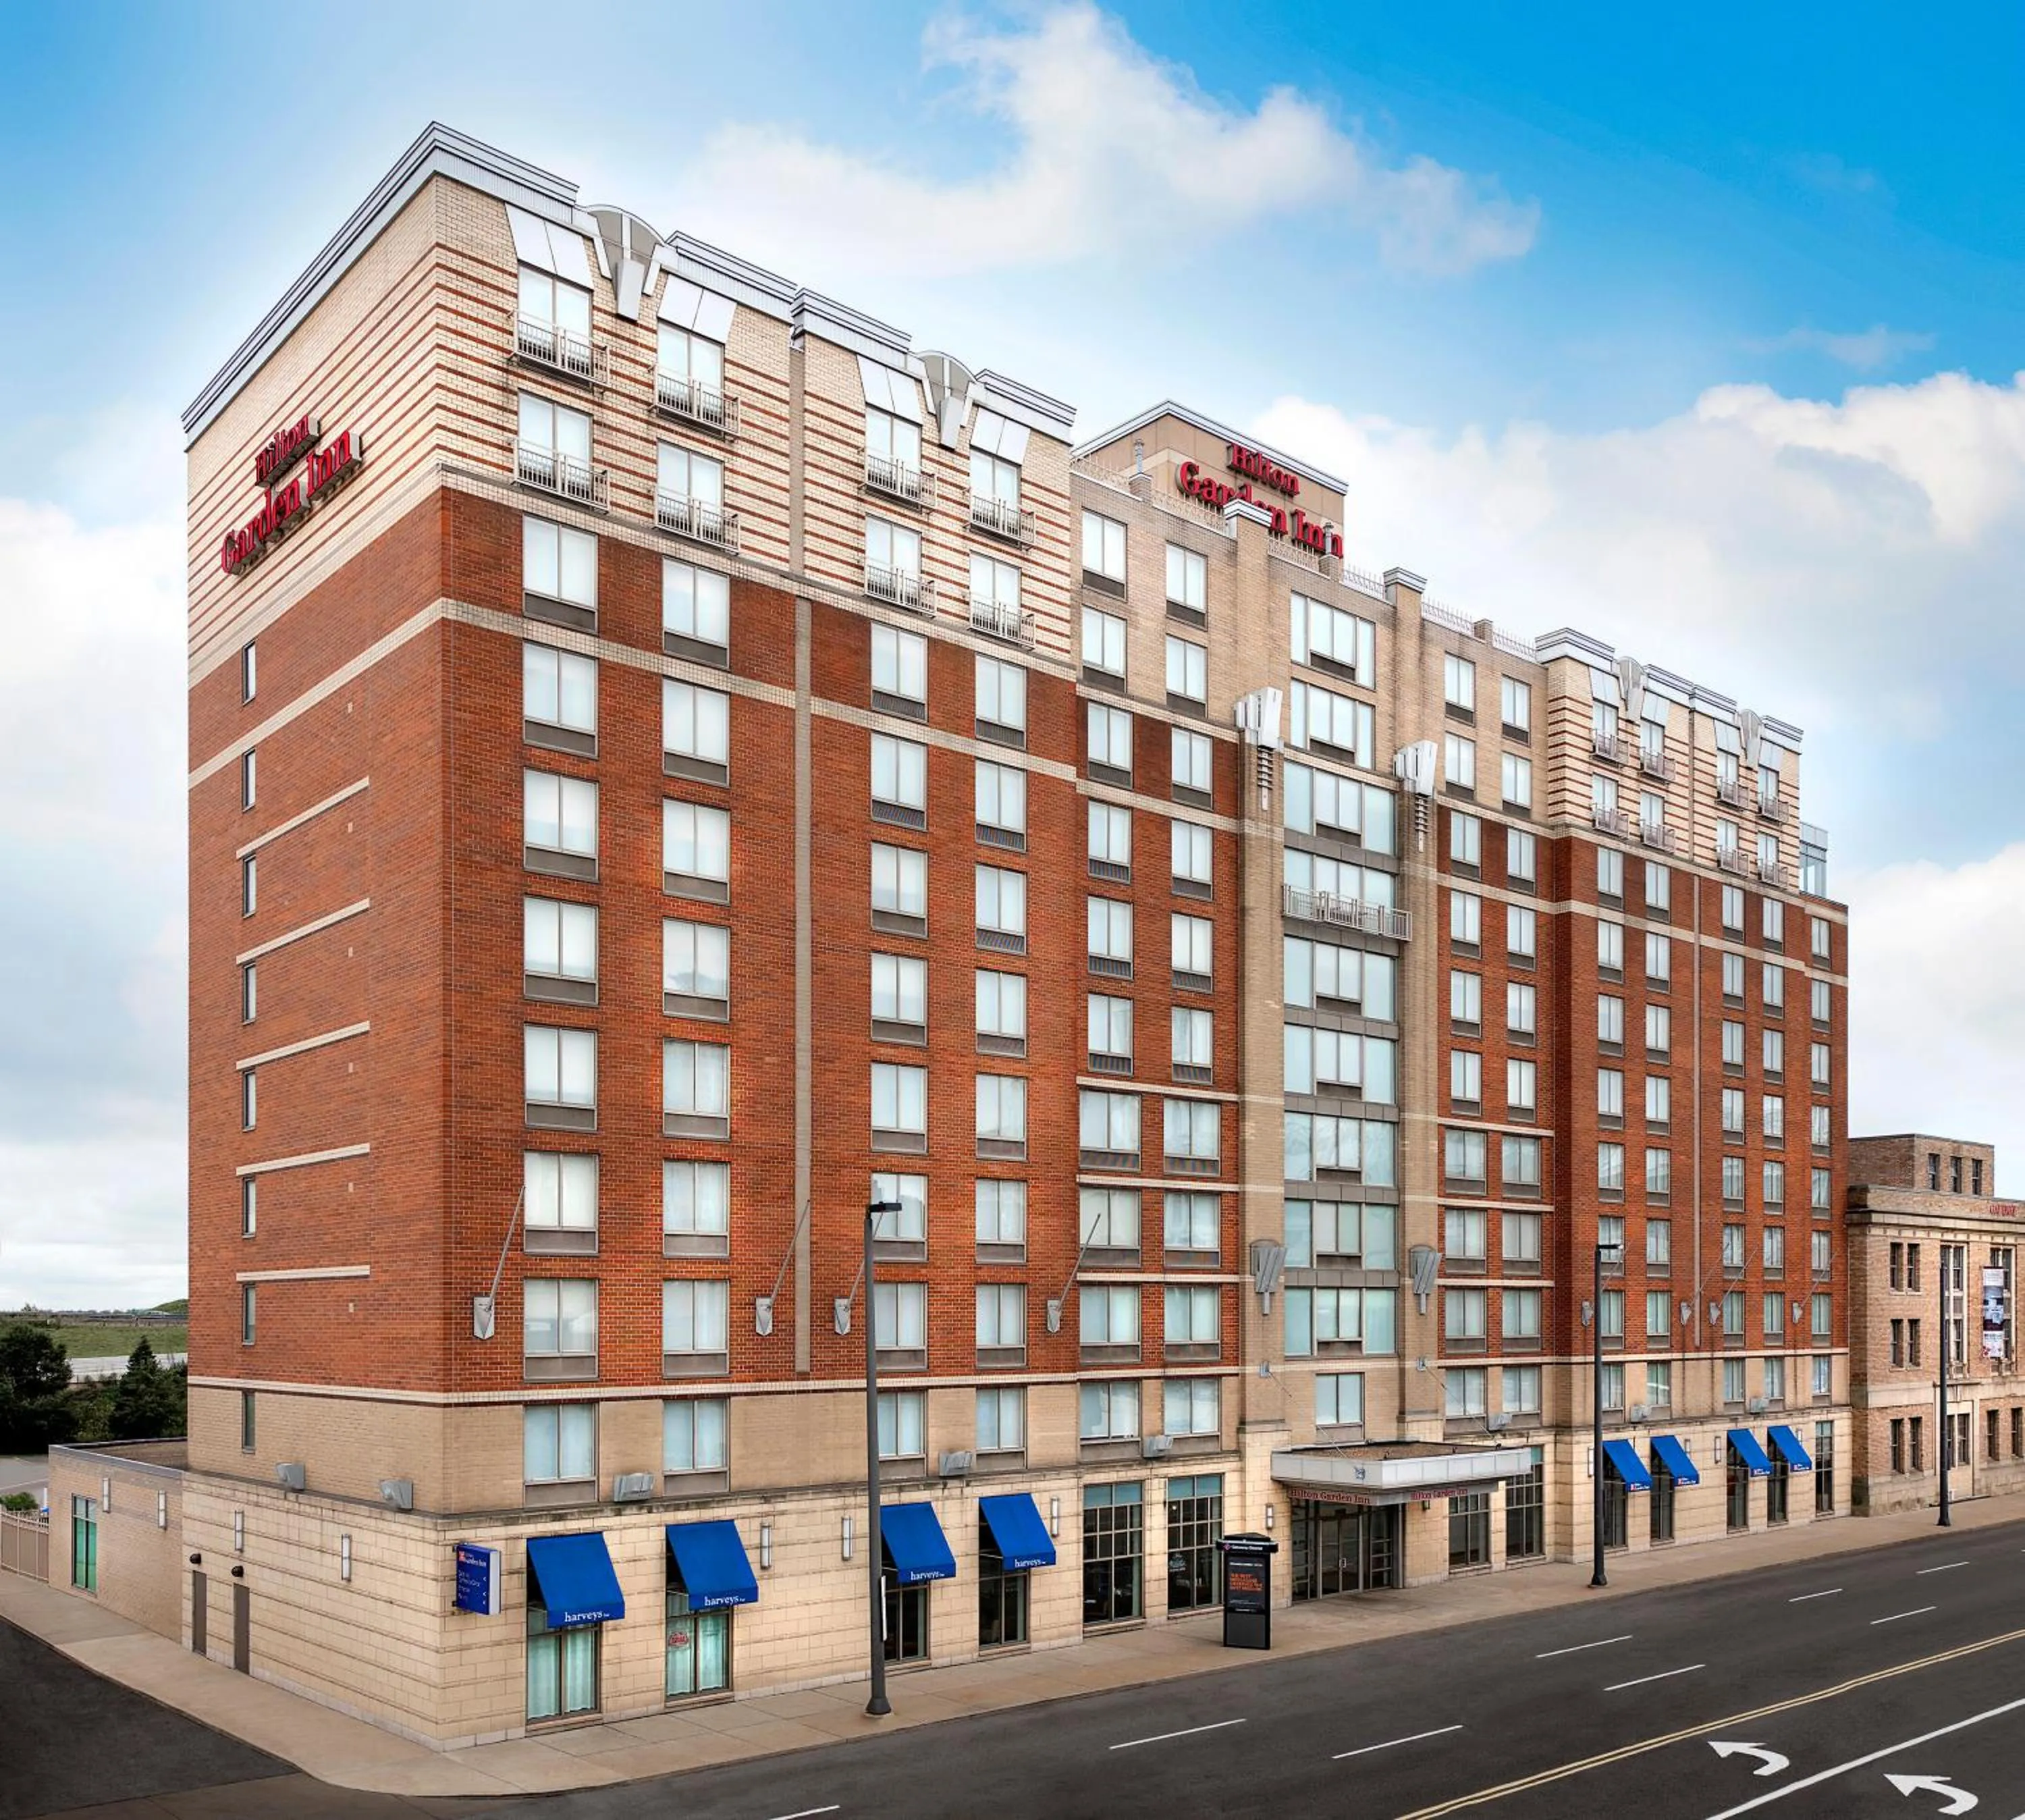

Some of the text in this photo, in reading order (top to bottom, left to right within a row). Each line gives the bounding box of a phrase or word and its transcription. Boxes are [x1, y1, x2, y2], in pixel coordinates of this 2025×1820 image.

[255, 414, 310, 485] Hilton
[1231, 443, 1300, 496] Hilton
[221, 430, 352, 574] Garden Inn
[1292, 509, 1343, 559] Inn
[1291, 1489, 1318, 1499] Hilton
[1321, 1491, 1352, 1503] Garden
[1015, 1559, 1041, 1568] harveys
[911, 1571, 939, 1580] harveys
[704, 1595, 739, 1606] harveys
[564, 1611, 603, 1622] harveys
